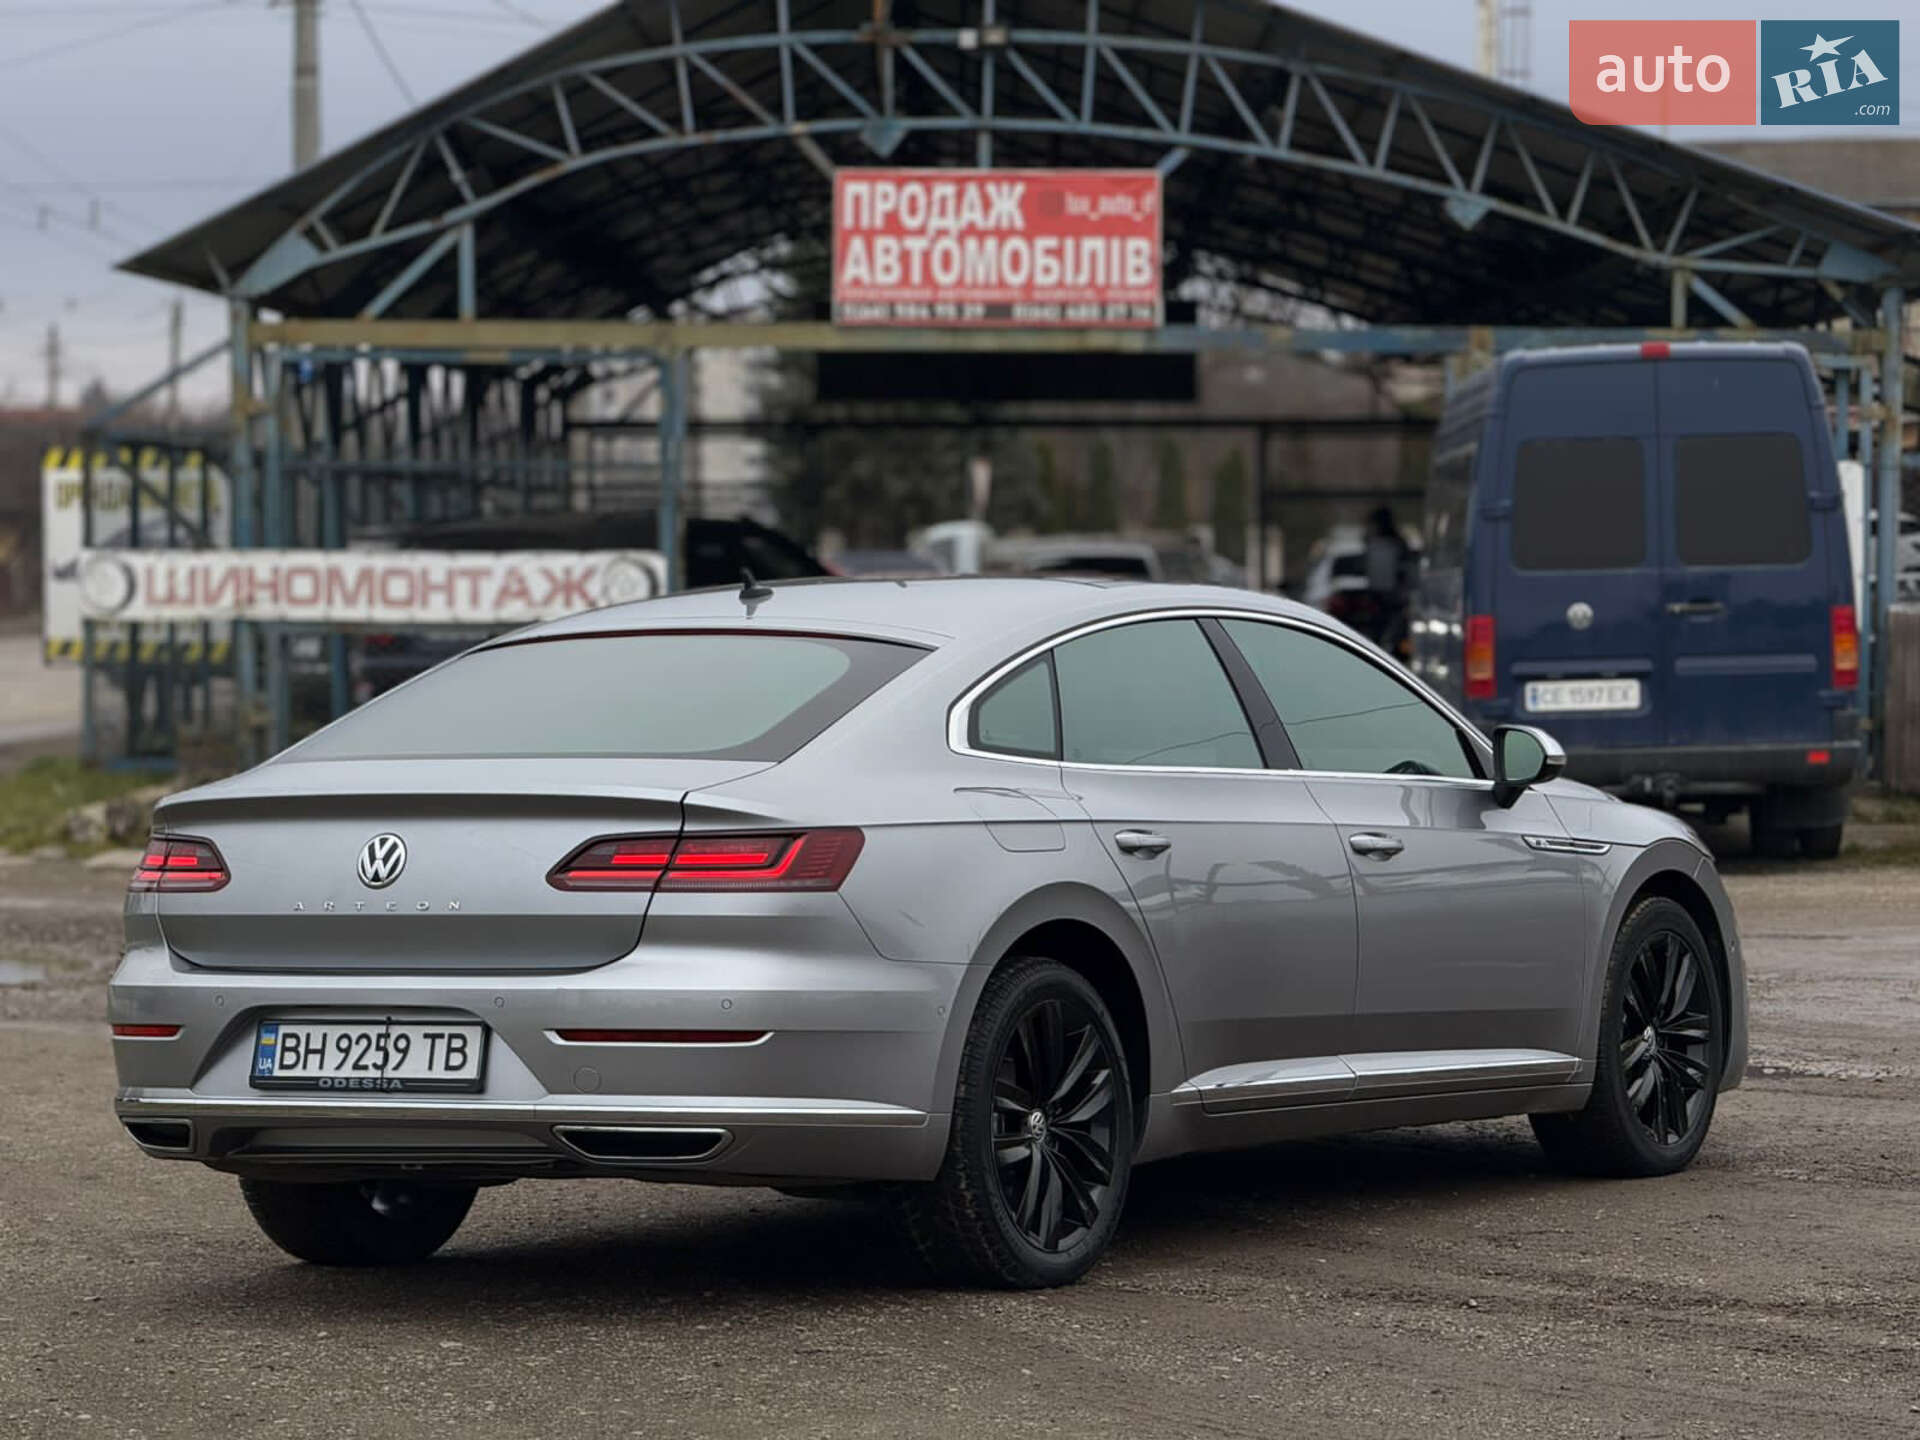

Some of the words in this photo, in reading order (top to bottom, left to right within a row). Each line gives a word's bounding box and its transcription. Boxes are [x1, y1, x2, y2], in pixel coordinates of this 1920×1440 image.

[843, 181, 1025, 237] ПРОДАЖ
[843, 236, 1152, 286] АВТОМОБІЛІВ
[143, 565, 599, 608] ШИНОМОНТАЖ
[293, 901, 461, 912] ARTEON
[258, 1057, 272, 1070] UA
[278, 1032, 328, 1071] BH
[334, 1032, 411, 1071] 9259
[423, 1032, 468, 1072] TB
[318, 1078, 404, 1089] ODESSA
